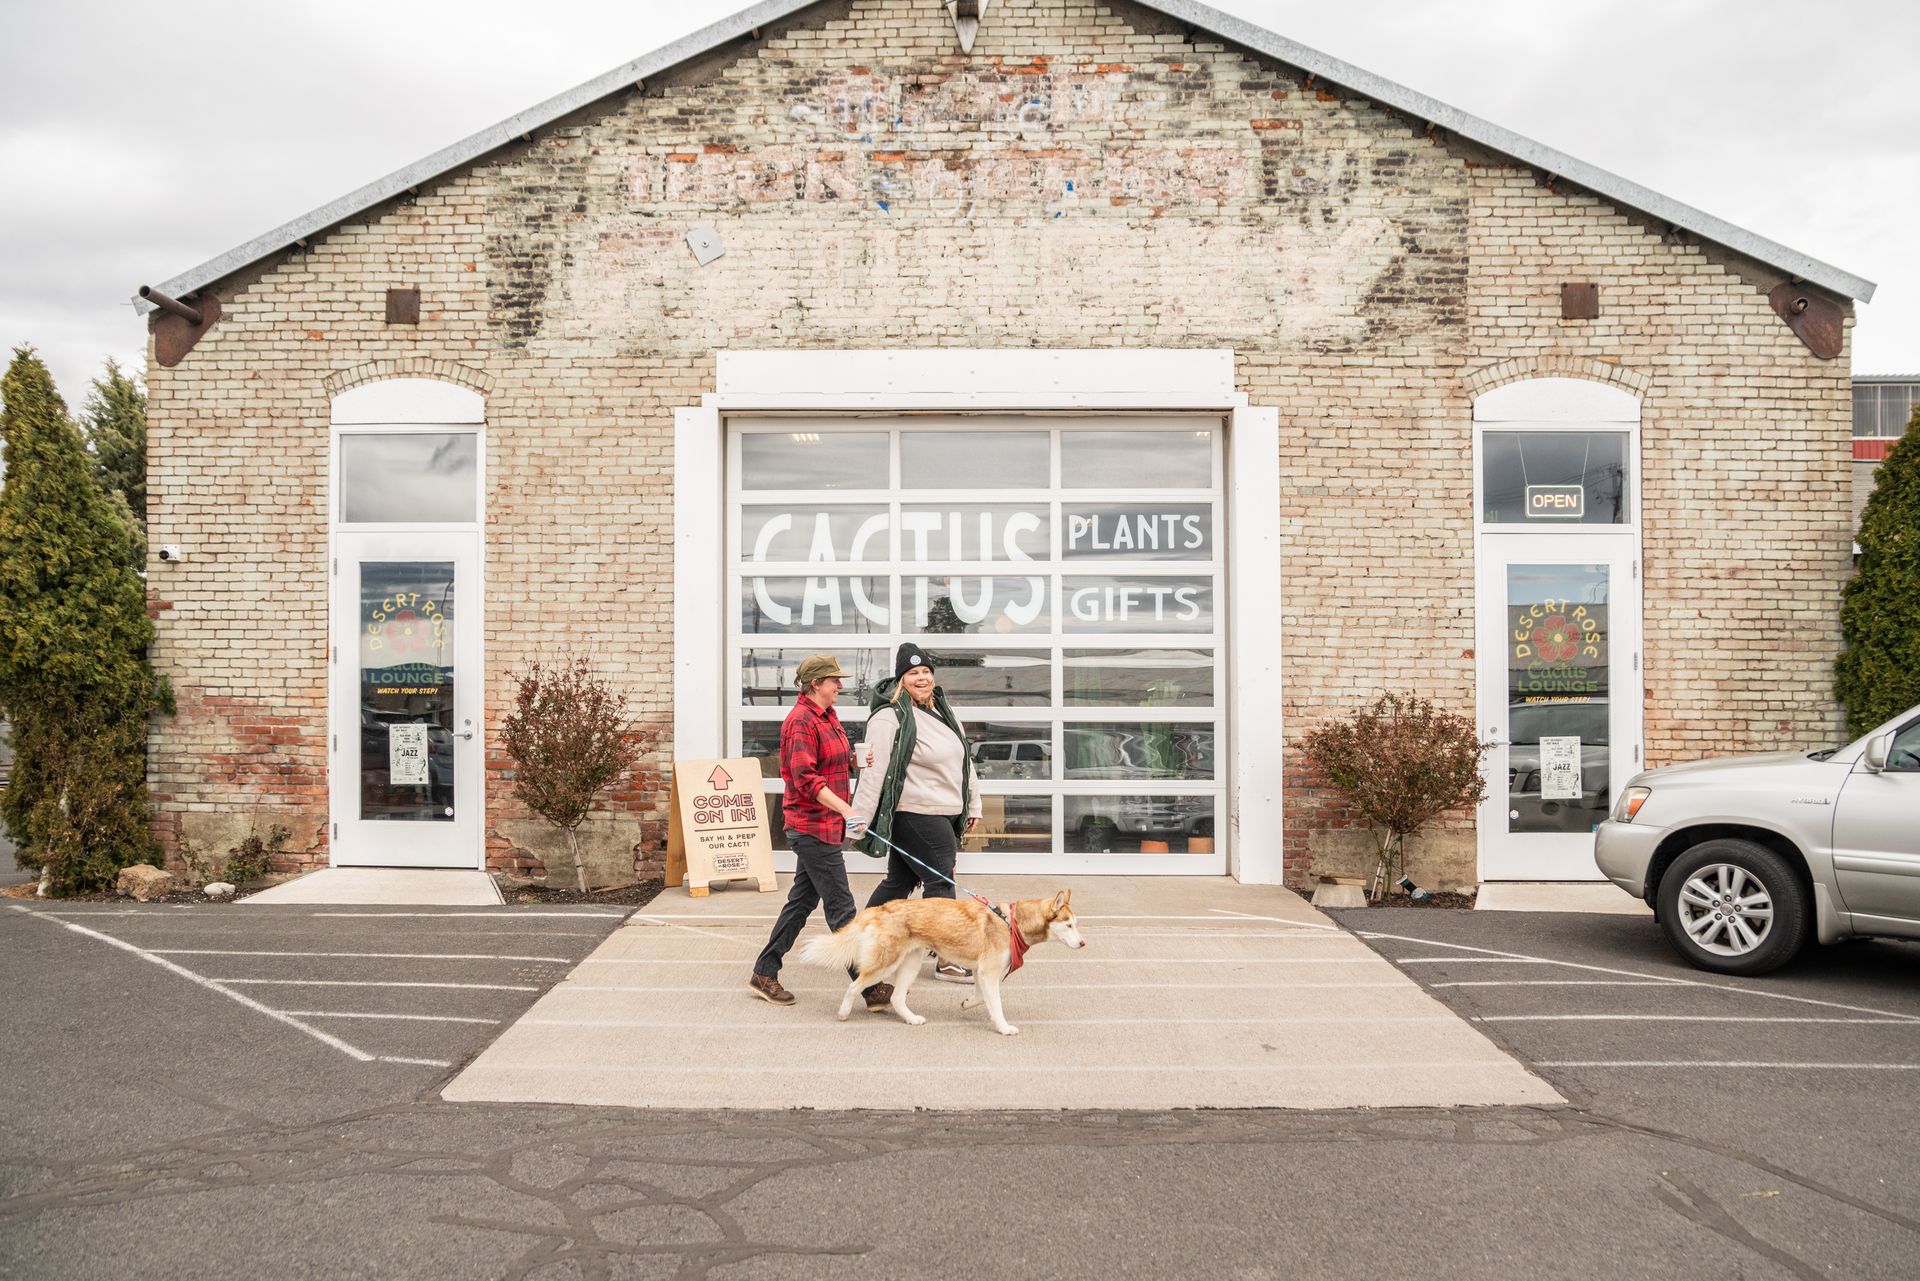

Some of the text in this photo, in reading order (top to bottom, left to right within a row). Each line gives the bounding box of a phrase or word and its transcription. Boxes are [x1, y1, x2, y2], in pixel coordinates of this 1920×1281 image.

[1532, 494, 1577, 508] OPEN
[1068, 514, 1204, 550] PLANTS
[753, 512, 1046, 628] CACTUS
[1070, 587, 1201, 622] GIFTS
[368, 593, 447, 651] DESERT ROSE
[1515, 598, 1600, 658] DESERT ROSE
[1528, 660, 1587, 679] Cactus
[371, 672, 445, 684] LOUNGE
[1519, 680, 1598, 692] LOUNGE
[377, 687, 438, 695] WATCH YOUR STEP!
[402, 749, 418, 757] JAZZ
[693, 794, 753, 809] COME
[694, 808, 756, 824] ON IN!
